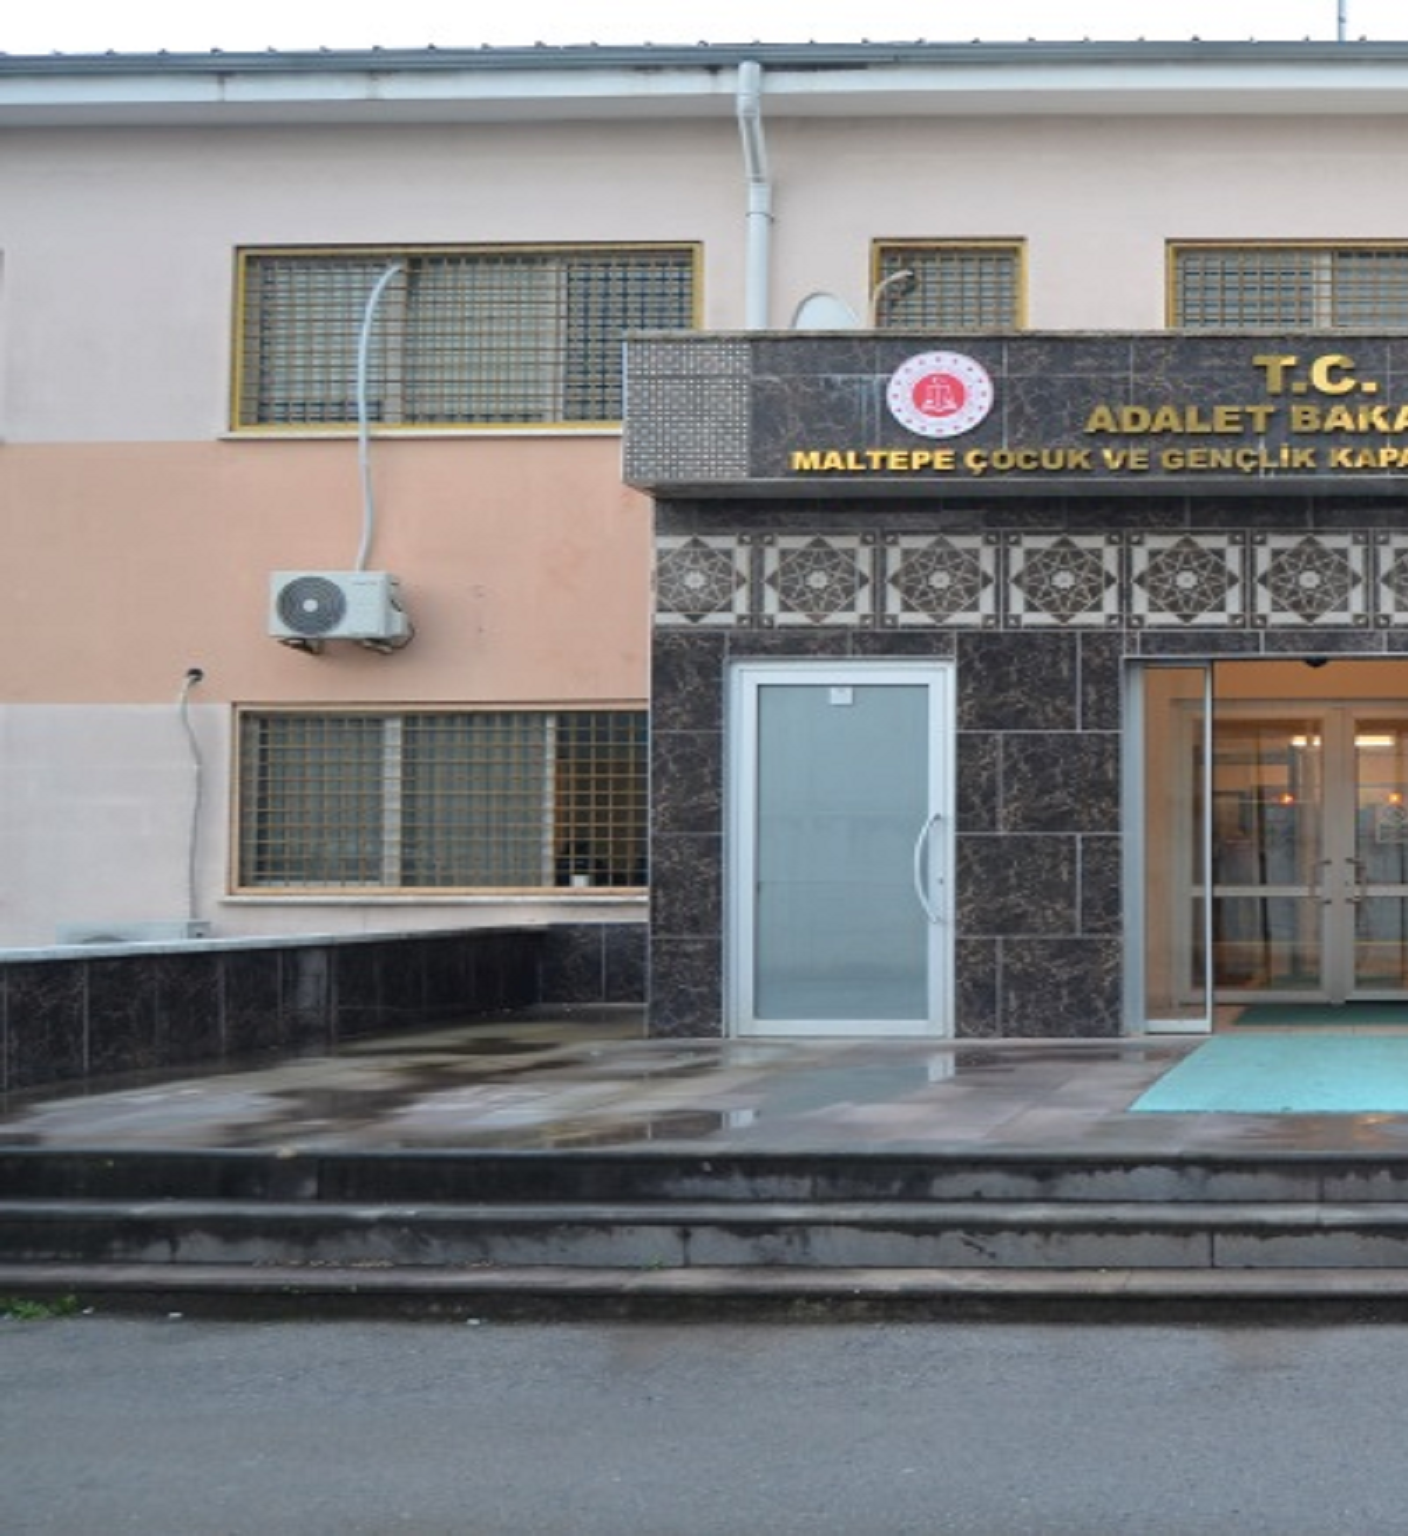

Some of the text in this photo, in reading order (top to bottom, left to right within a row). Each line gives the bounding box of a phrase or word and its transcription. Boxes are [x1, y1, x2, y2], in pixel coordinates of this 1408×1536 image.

[1252, 353, 1378, 394] T.C.
[1086, 405, 1275, 432] ADALET
[790, 449, 956, 471] MALTEPE
[964, 448, 1091, 475] ÇOCUK
[1101, 447, 1149, 471] VE
[1160, 443, 1317, 473] GENÇLİK
